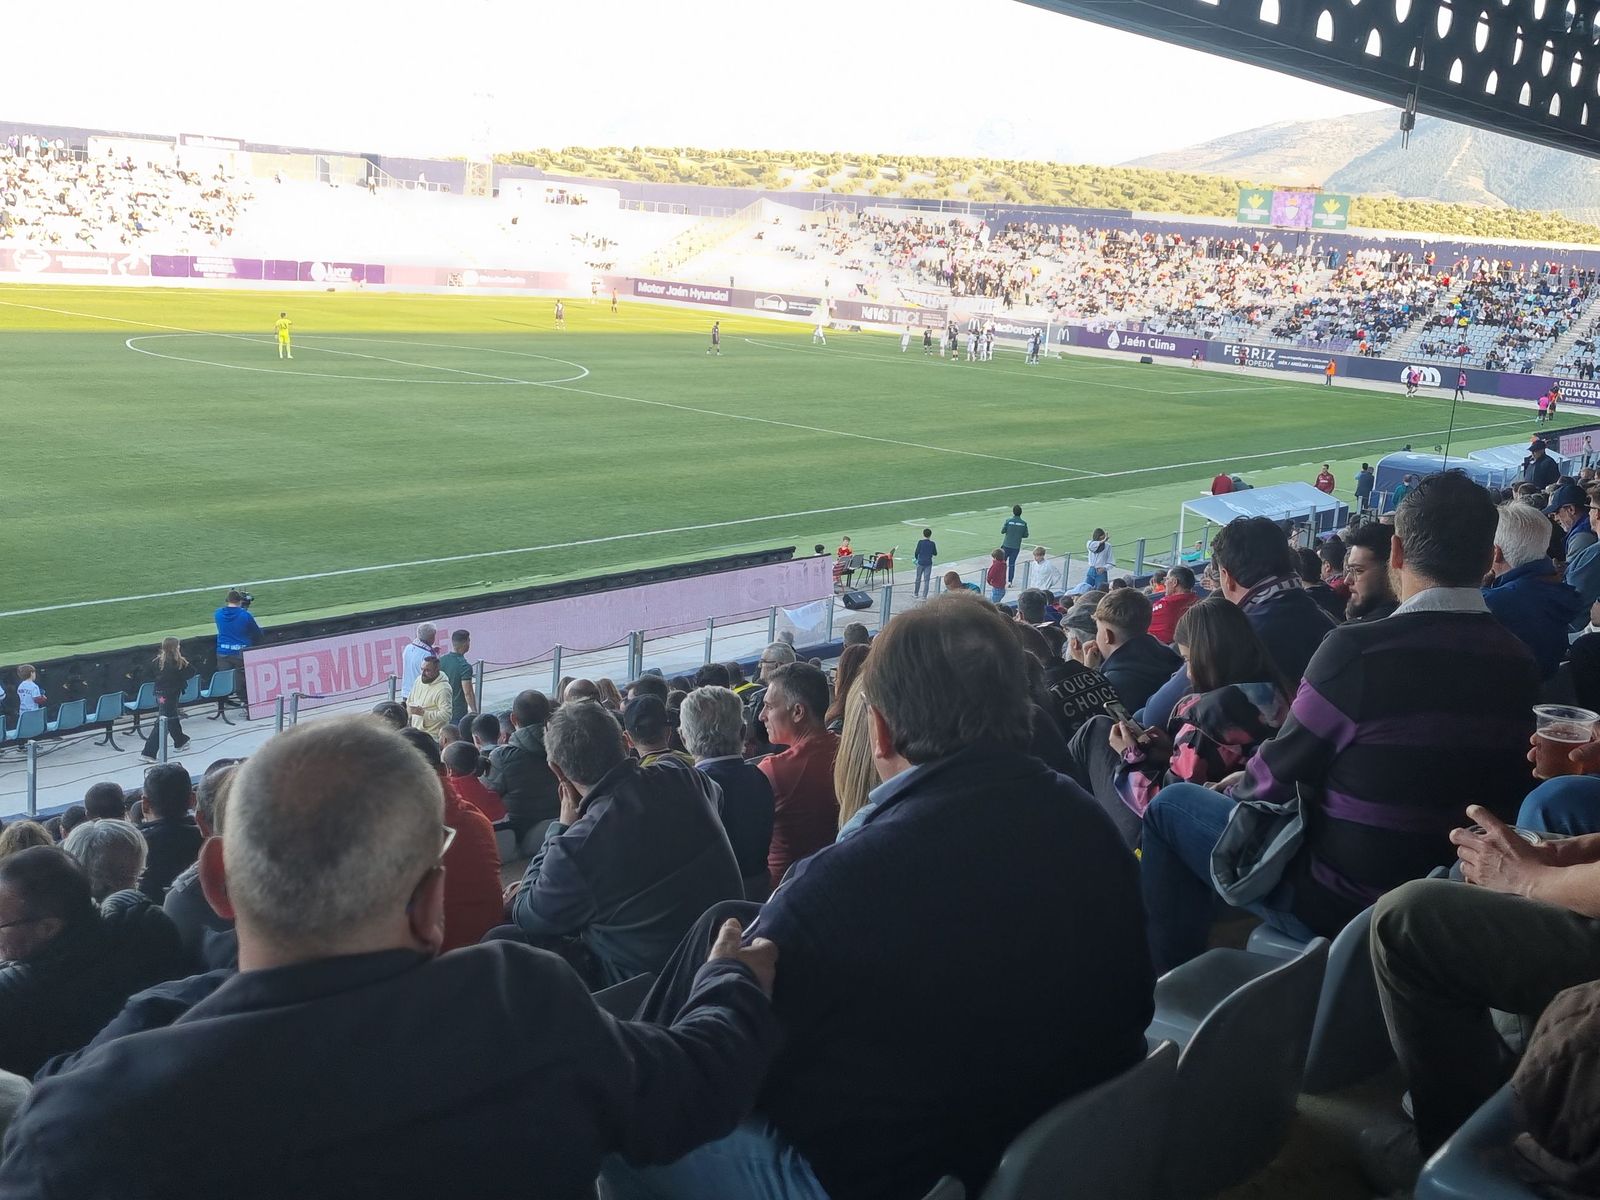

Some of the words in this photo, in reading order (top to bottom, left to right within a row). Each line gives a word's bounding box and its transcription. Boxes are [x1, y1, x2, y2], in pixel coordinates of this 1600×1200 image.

[637, 282, 666, 294] Motor
[666, 285, 689, 297] Jaén
[690, 288, 729, 301] Hyundai
[1121, 335, 1146, 348] Jaén
[1148, 338, 1176, 351] Clima
[1234, 358, 1275, 369] OTOPEDIA
[1559, 380, 1600, 390] CERVEZA
[246, 629, 449, 703] IPERMUEE
[1050, 670, 1105, 698] TOUGH
[1063, 685, 1118, 717] CHOICE
